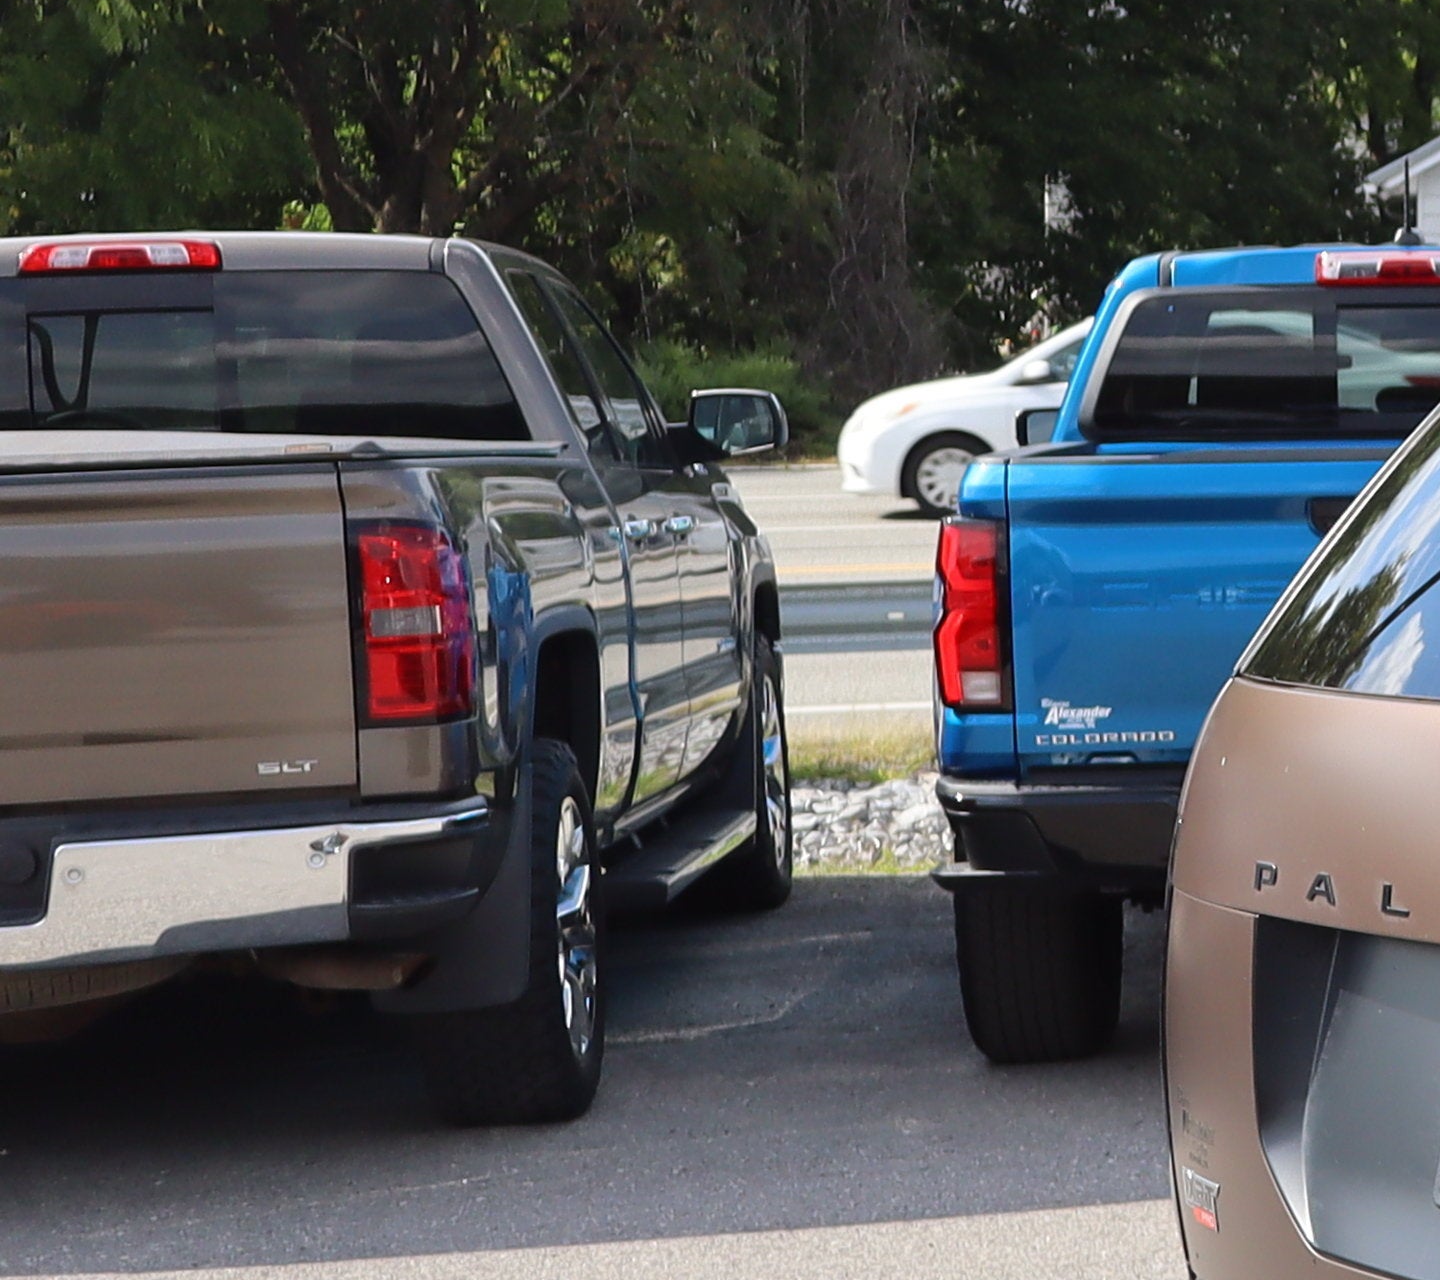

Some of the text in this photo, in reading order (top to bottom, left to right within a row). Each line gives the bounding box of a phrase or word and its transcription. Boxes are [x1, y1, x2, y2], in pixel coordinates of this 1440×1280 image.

[1044, 705, 1113, 726] Alexander
[1036, 730, 1175, 746] COLORADO
[257, 759, 319, 775] SLT
